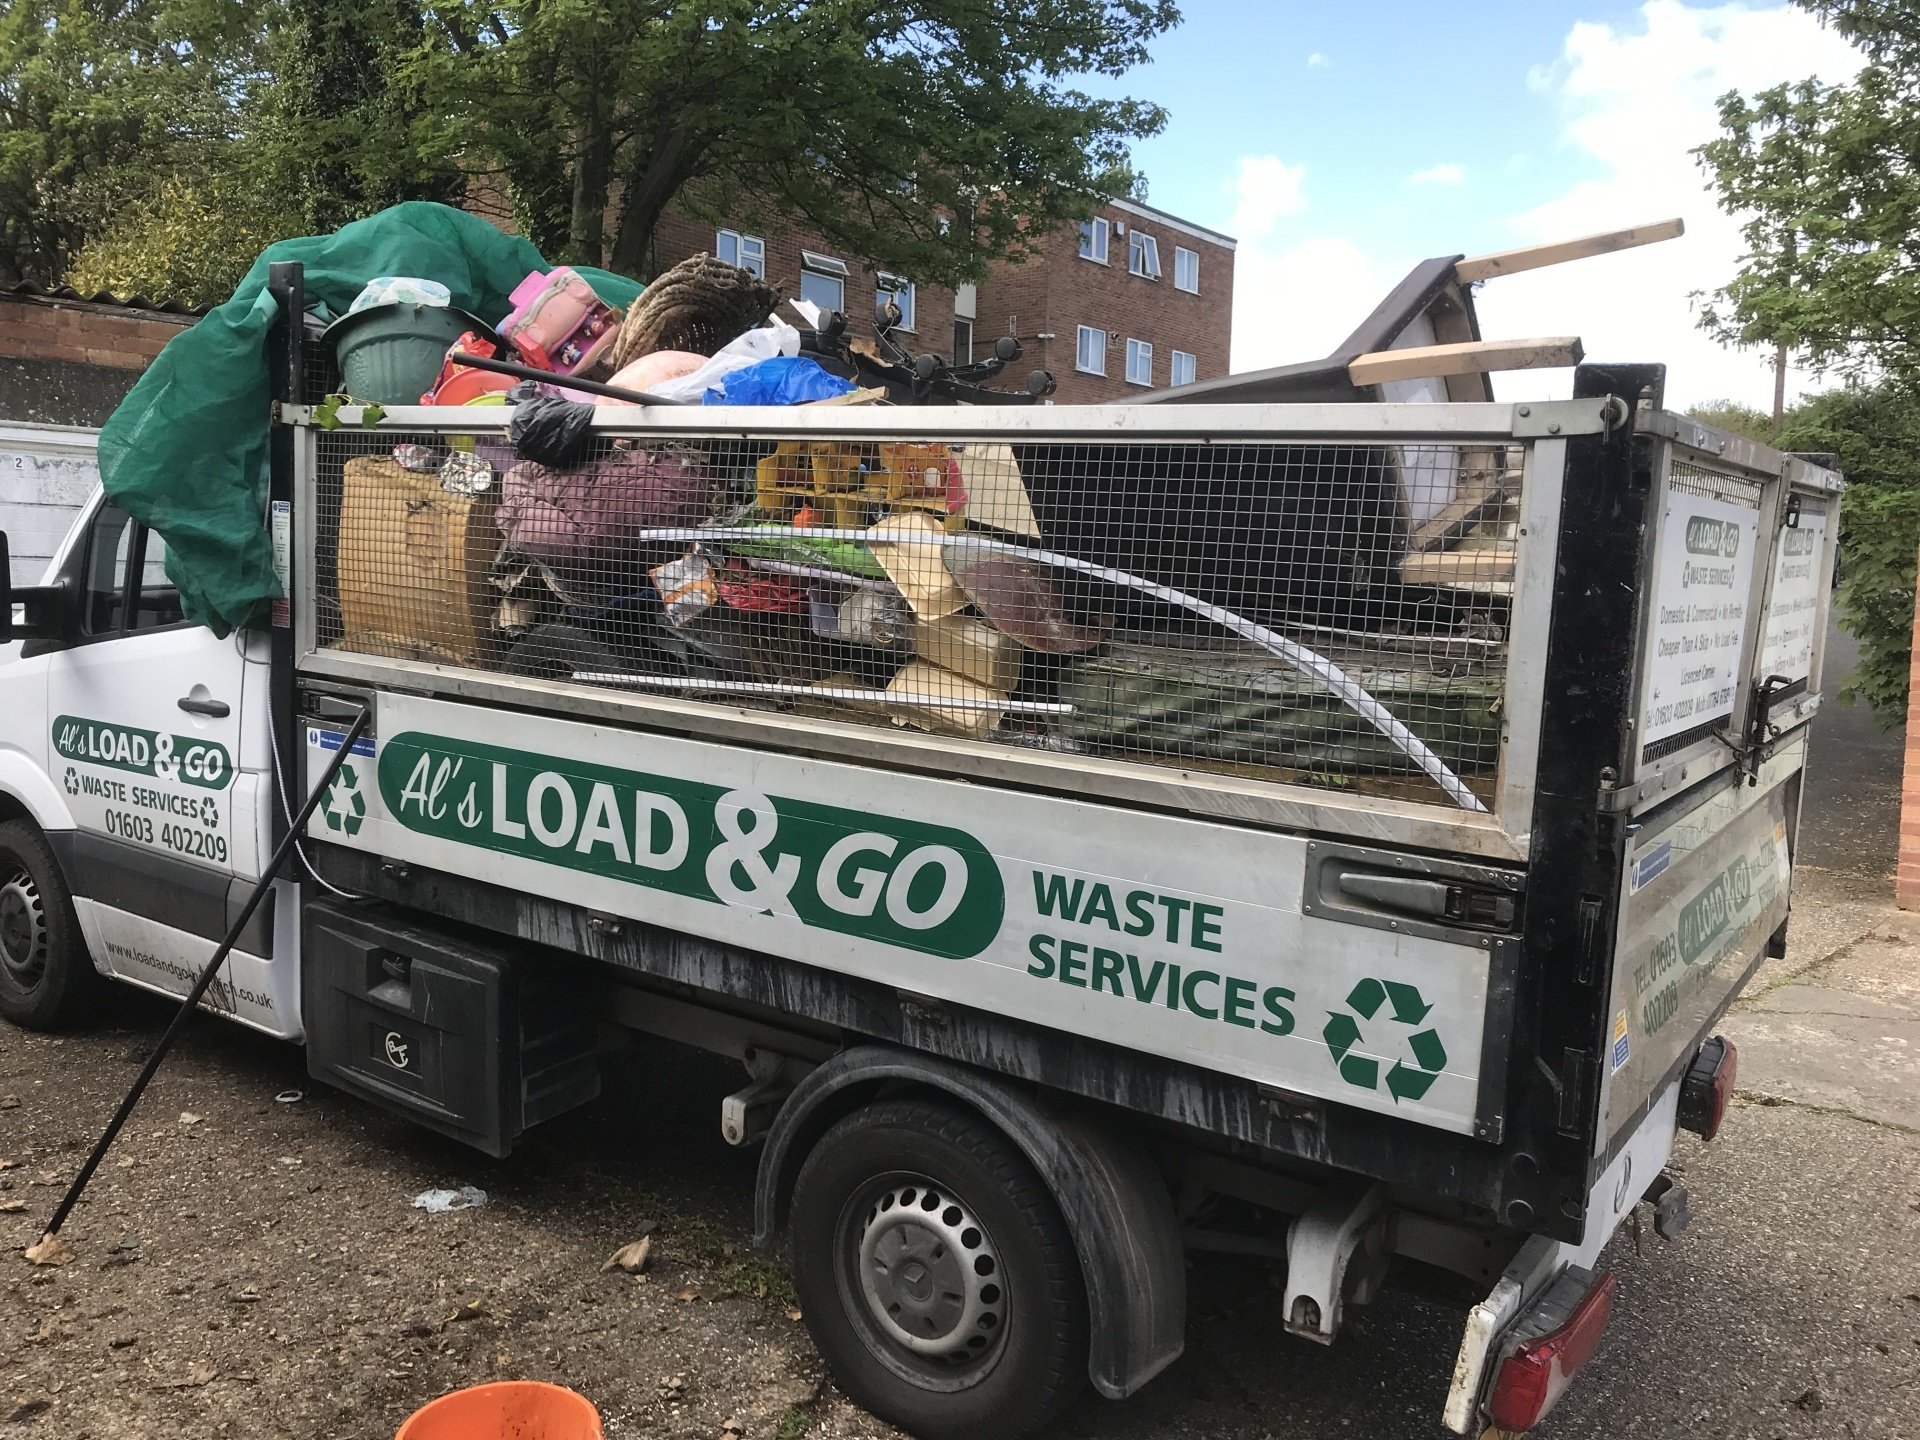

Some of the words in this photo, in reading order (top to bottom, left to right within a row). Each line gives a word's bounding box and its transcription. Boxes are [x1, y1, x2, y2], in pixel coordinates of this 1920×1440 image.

[15, 457, 22, 468] 2
[1699, 523, 1719, 550] LOAD
[1719, 520, 1727, 557] &
[1726, 528, 1738, 553] GO
[1660, 605, 1685, 624] Domestic
[1658, 638, 1680, 659] Cheaper
[59, 722, 86, 755] Al's
[88, 726, 149, 767] LOAD
[154, 733, 181, 780] &
[185, 746, 224, 782] GO
[81, 774, 126, 803] WASTE
[132, 786, 198, 819] SERVICES
[105, 808, 154, 844] 01603
[161, 823, 227, 863] 402209
[400, 752, 483, 829] Al's
[492, 762, 690, 872] LOAD
[704, 788, 804, 920] &
[816, 832, 969, 931] GO
[1032, 870, 1224, 954] WASTE
[1698, 885, 1725, 942] LOAD
[1734, 861, 1749, 899] GO
[1027, 933, 1296, 1037] SERVICES
[1651, 932, 1678, 983] 01603
[1643, 980, 1679, 1038] 402209
